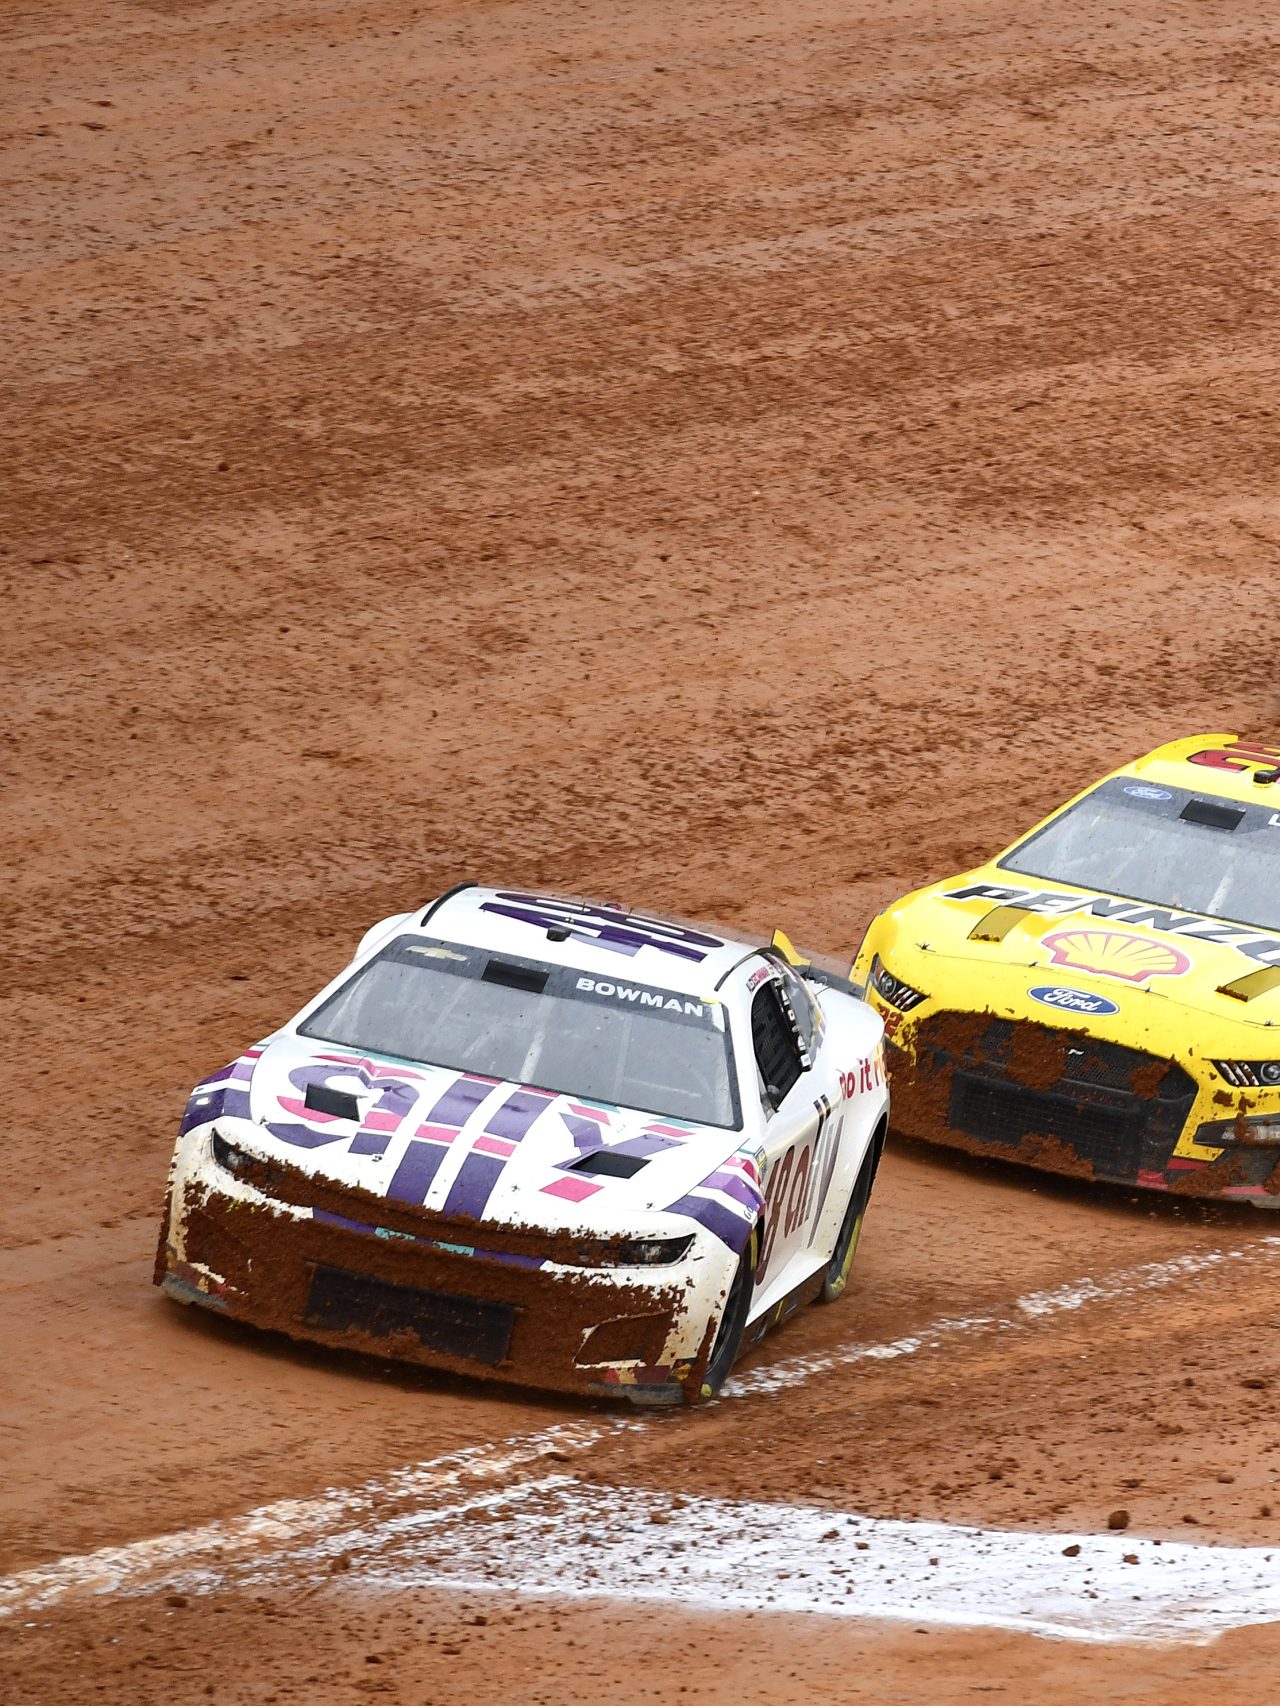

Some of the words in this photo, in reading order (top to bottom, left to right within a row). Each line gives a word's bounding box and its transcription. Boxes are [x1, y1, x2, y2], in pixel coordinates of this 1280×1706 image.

[576, 976, 703, 1018] BOWMAN
[1043, 987, 1105, 1013] Ford
[858, 1057, 873, 1094] it
[265, 1046, 704, 1224] ally
